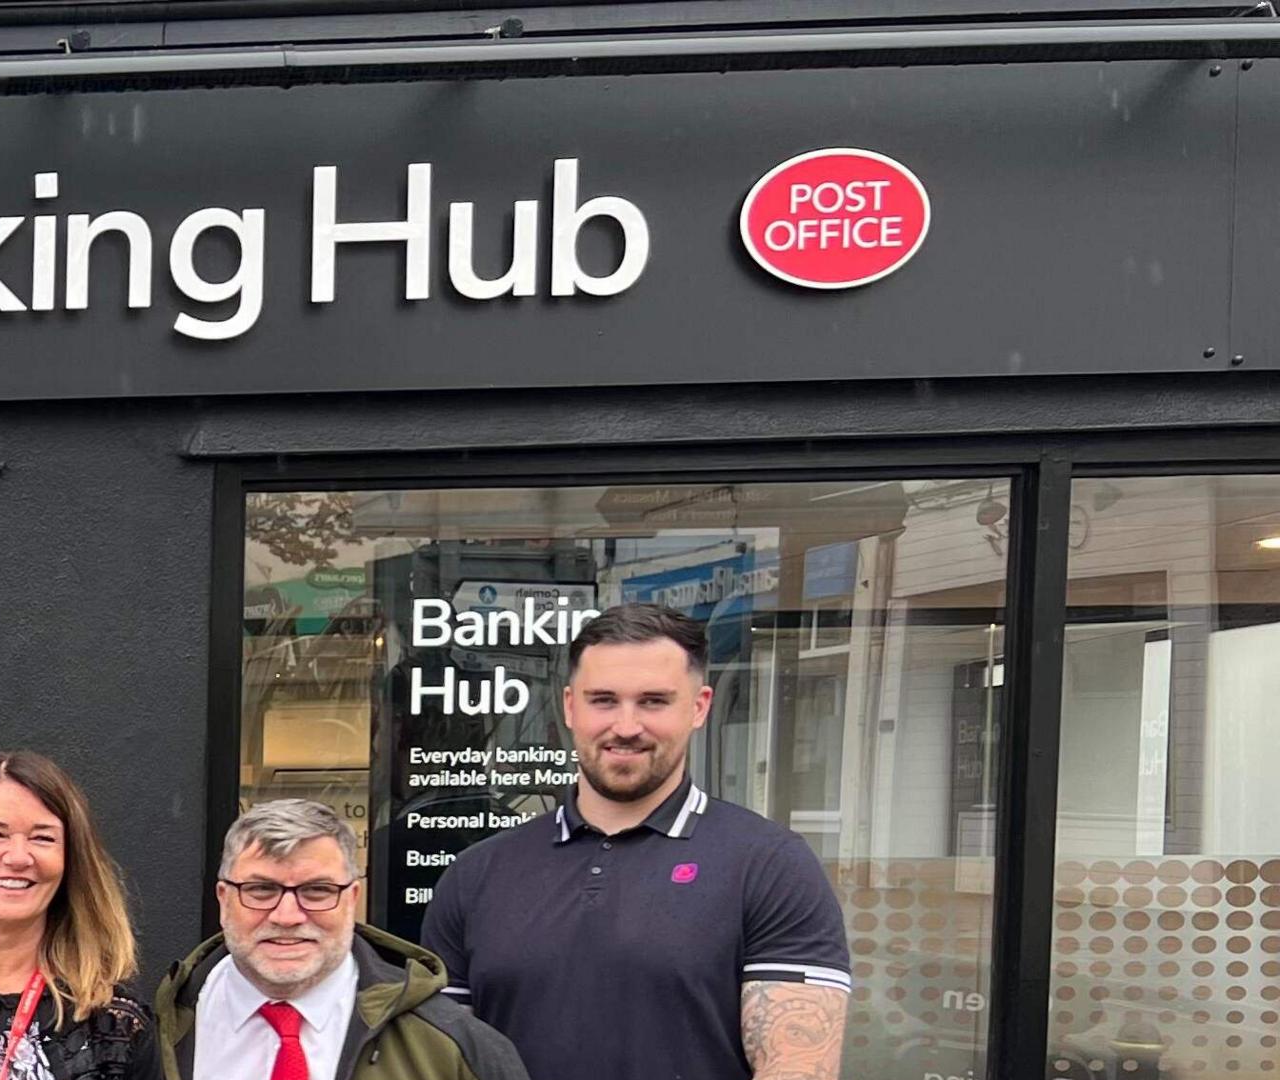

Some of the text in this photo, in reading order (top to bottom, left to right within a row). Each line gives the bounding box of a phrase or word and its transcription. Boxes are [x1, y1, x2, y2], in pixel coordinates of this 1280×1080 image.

[790, 181, 890, 214] POST
[309, 158, 651, 303] Hub
[764, 217, 902, 252] OFFICE
[412, 596, 601, 647] Bankin
[410, 666, 530, 716] Hub
[409, 747, 492, 767] Everyday
[495, 746, 567, 766] banking
[408, 770, 487, 787] available
[491, 770, 531, 786] here
[406, 812, 537, 829] Personal bank
[406, 850, 456, 867] Busin
